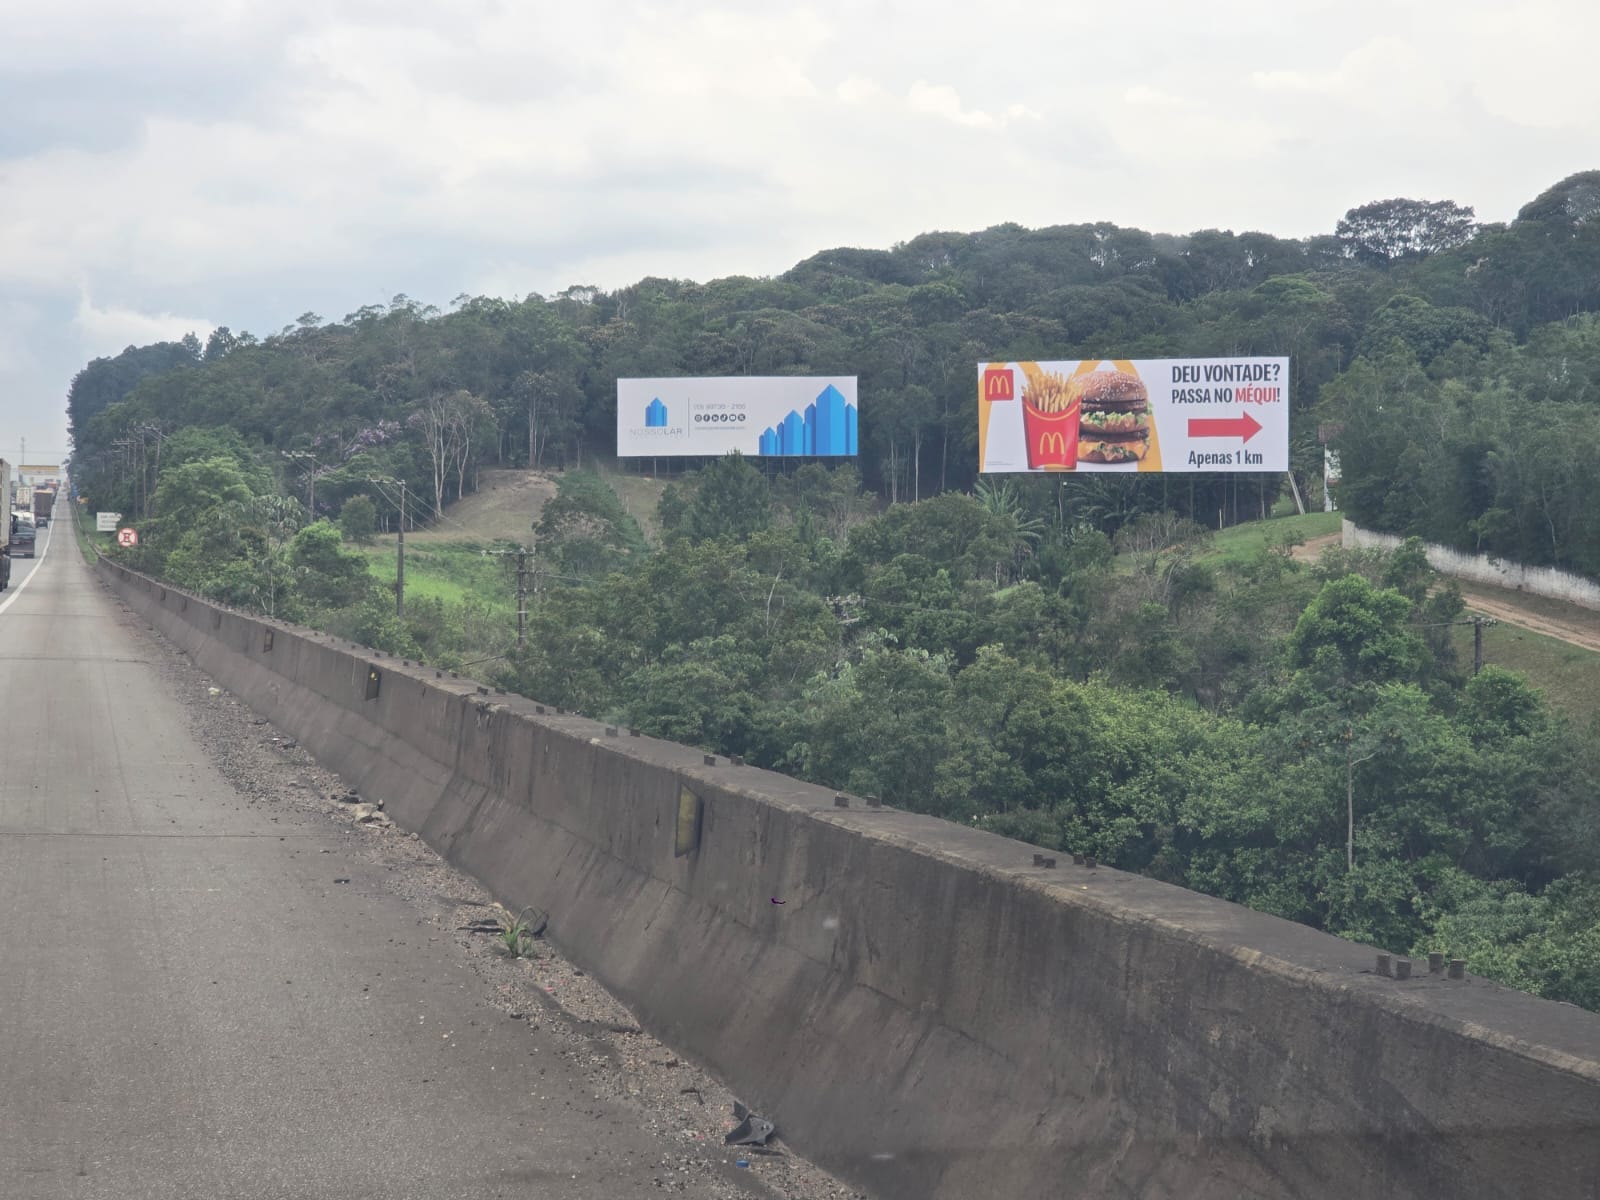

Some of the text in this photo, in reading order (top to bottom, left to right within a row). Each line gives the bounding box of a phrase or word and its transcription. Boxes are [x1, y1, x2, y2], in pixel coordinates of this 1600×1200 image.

[1172, 364, 1281, 383] DEU VONTADE?
[1171, 383, 1280, 405] PASSA NO MÉQUI!
[1188, 449, 1263, 469] Apenas 1 km
